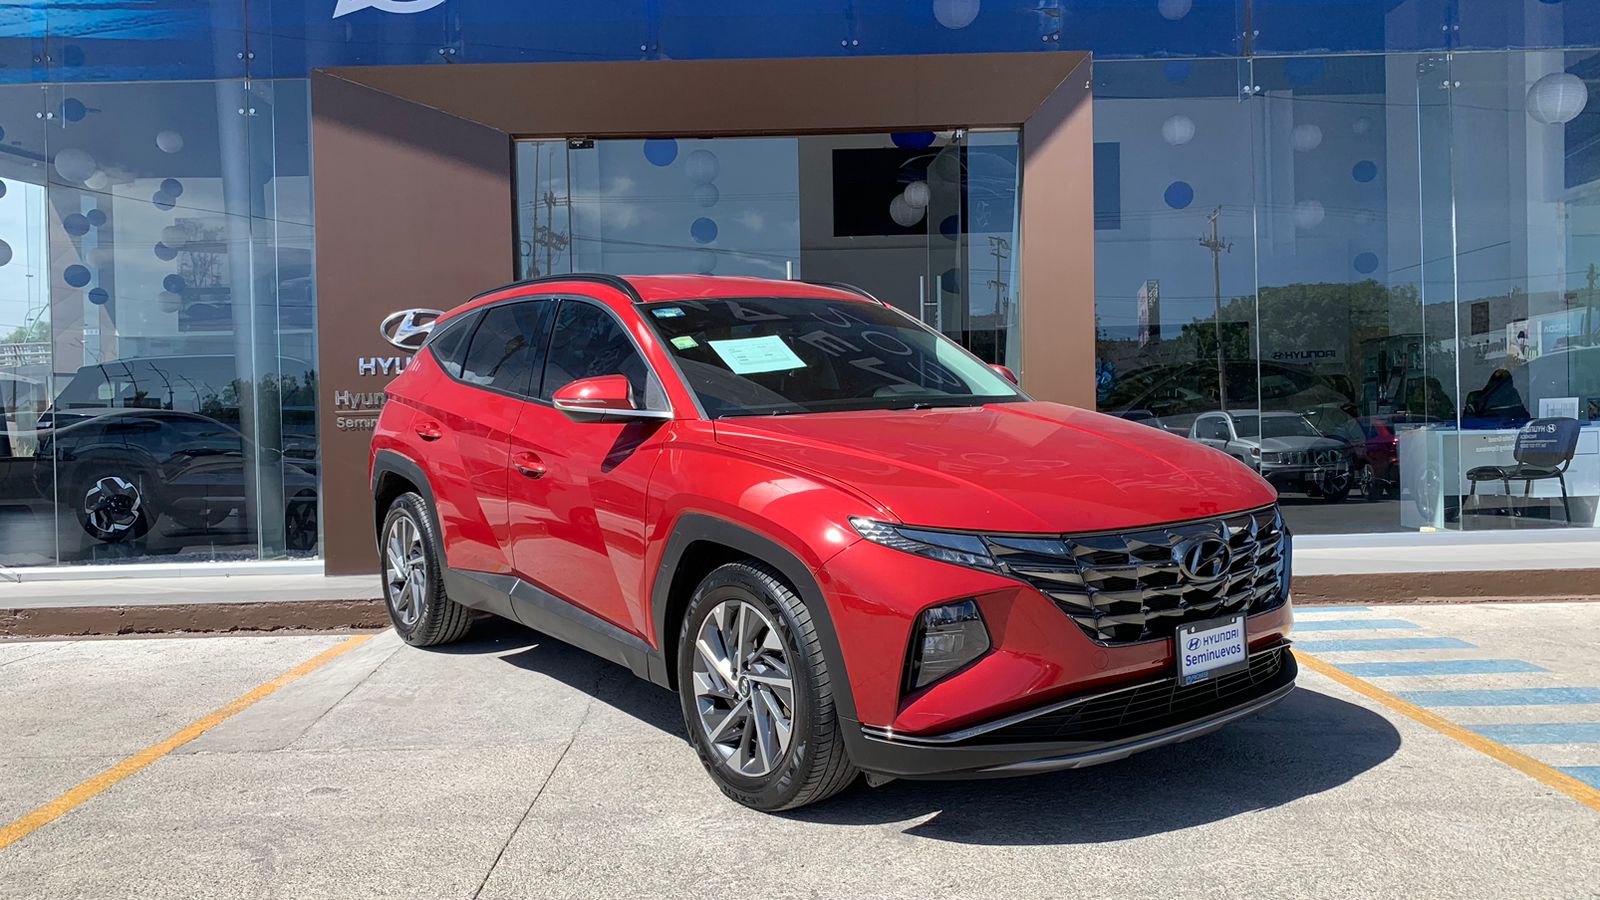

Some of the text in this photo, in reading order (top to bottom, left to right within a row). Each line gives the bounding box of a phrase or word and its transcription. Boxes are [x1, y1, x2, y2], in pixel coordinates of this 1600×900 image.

[1284, 350, 1336, 360] HYUNDAI
[335, 390, 386, 410] Hyun
[336, 416, 378, 428] Semin
[1203, 628, 1239, 646] HYUNDAI
[1185, 644, 1241, 666] Seminuevos
